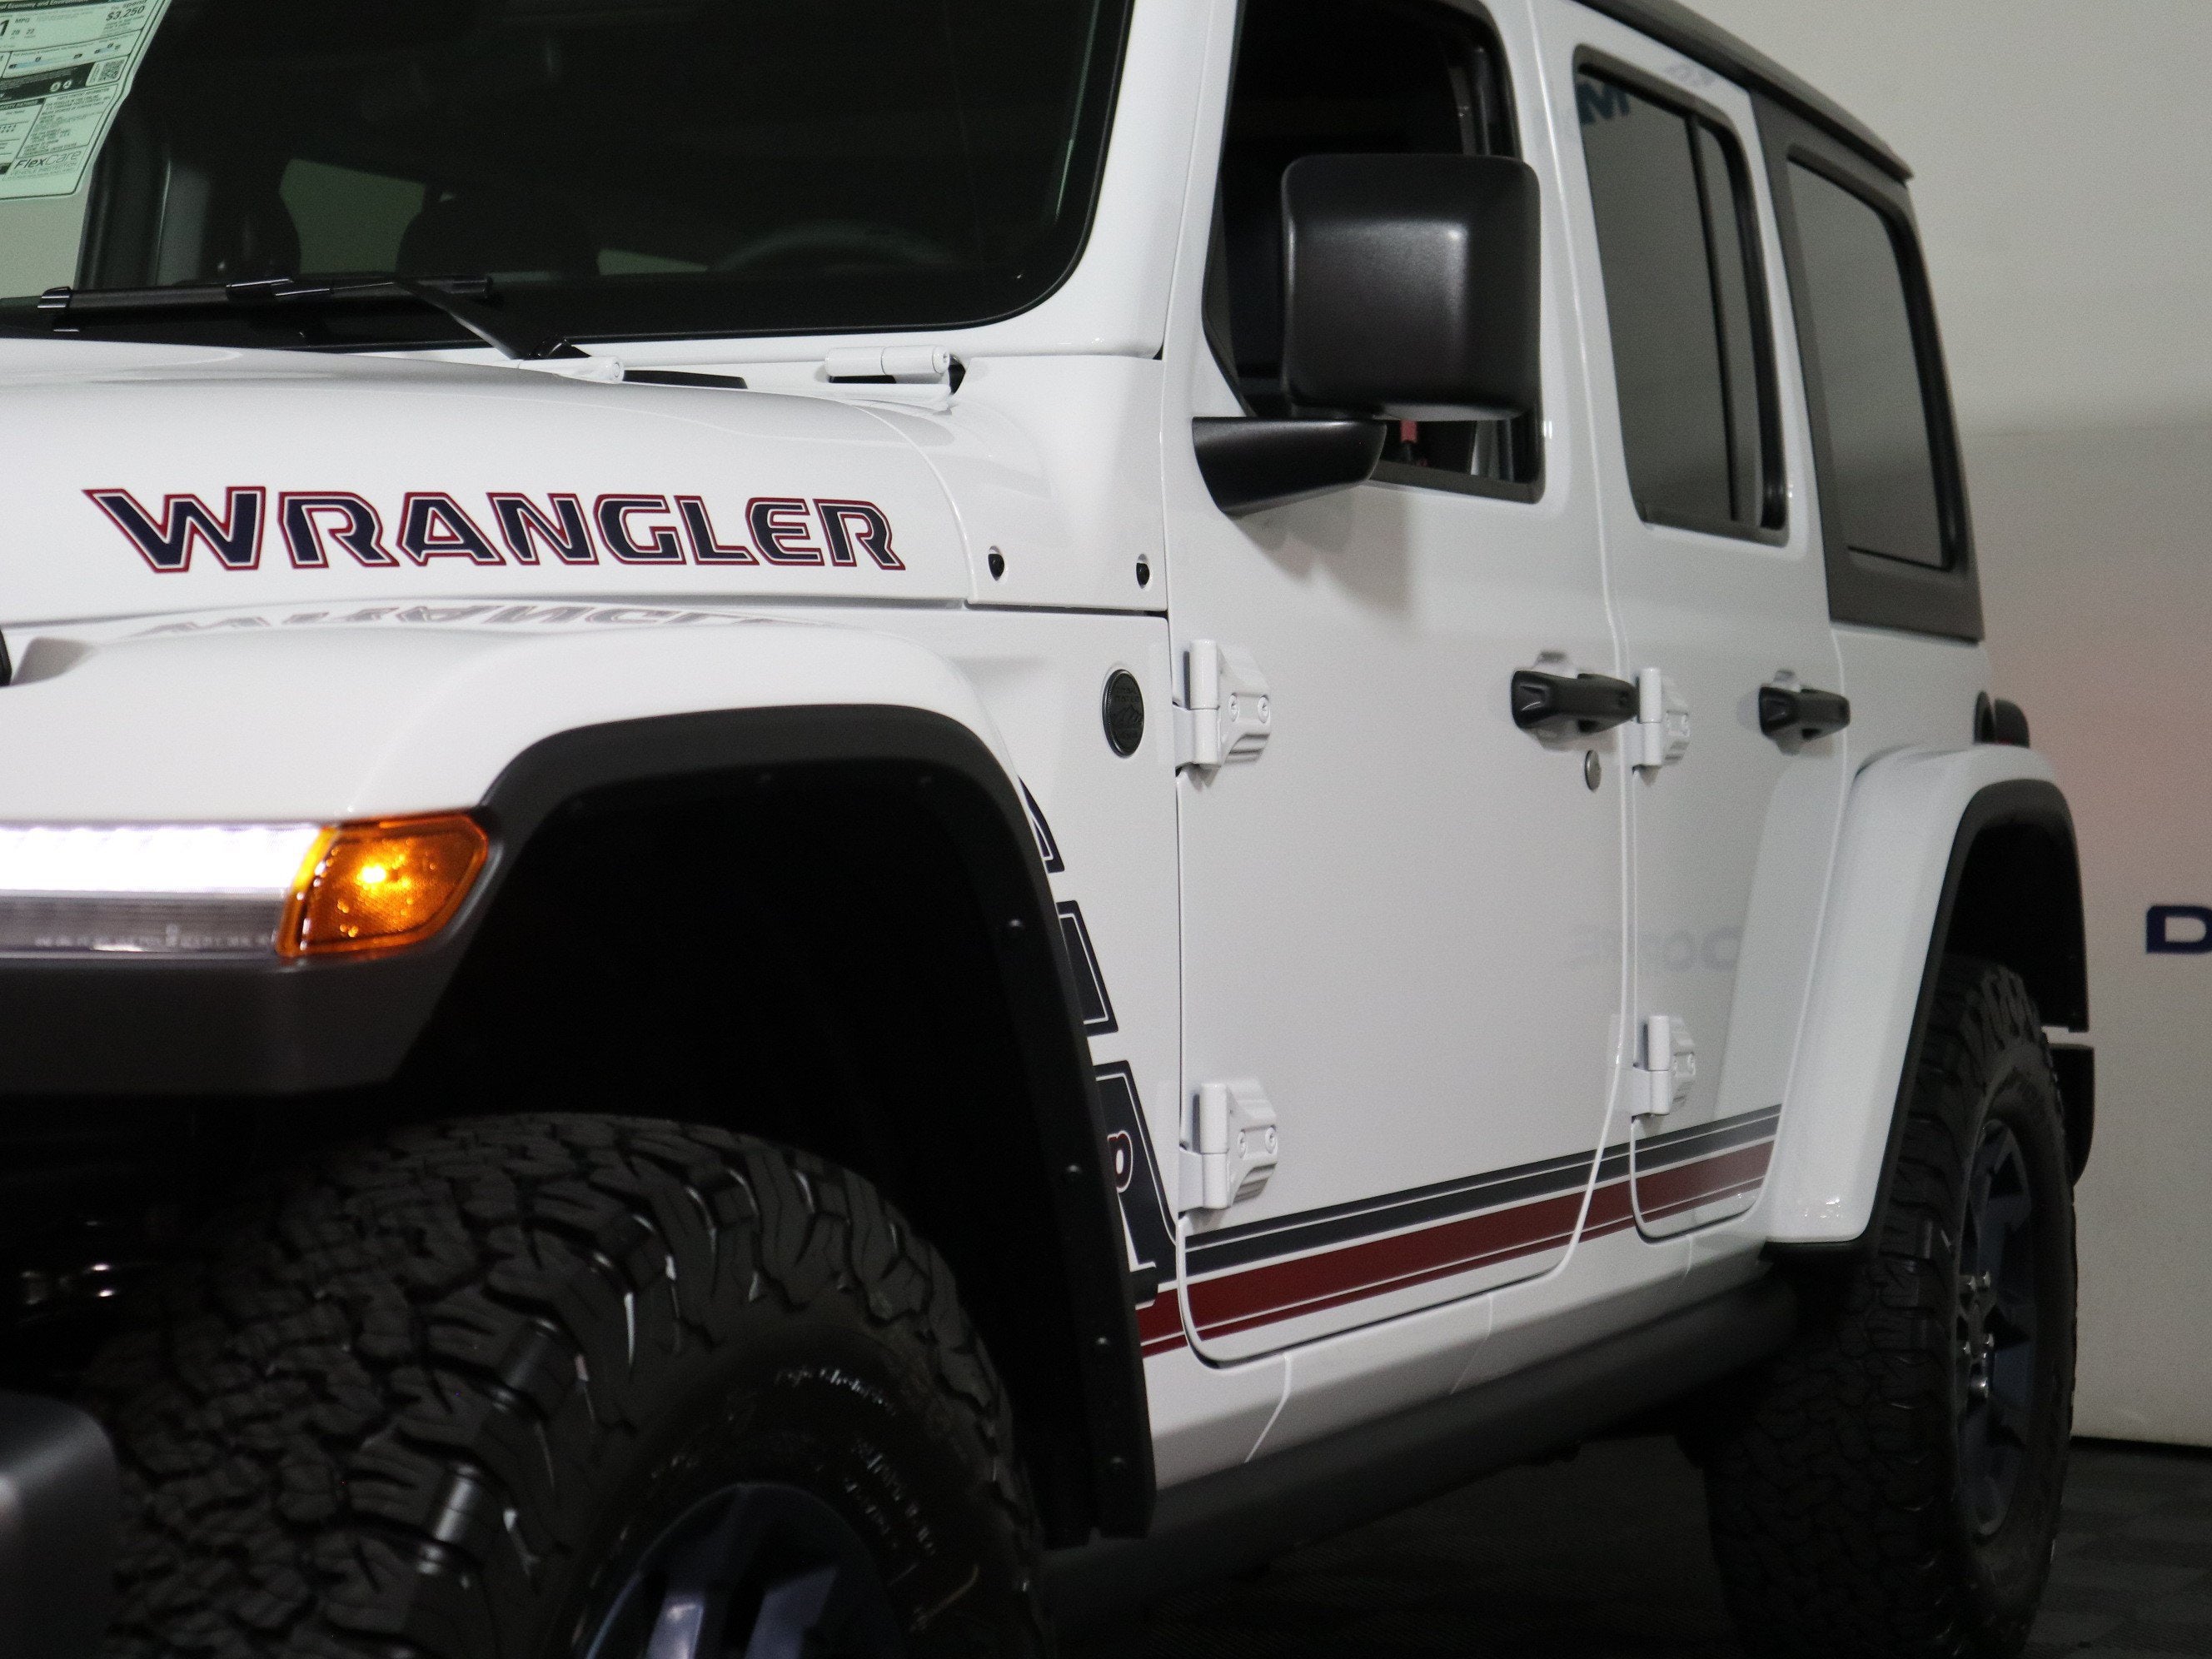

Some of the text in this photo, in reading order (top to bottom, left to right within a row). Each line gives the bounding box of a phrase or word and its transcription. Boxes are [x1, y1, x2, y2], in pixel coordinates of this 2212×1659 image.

[106, 5, 145, 21] $3,250
[14, 151, 82, 169] FlexCare
[81, 486, 906, 574] WRANGLER
[2145, 905, 2212, 954] D
